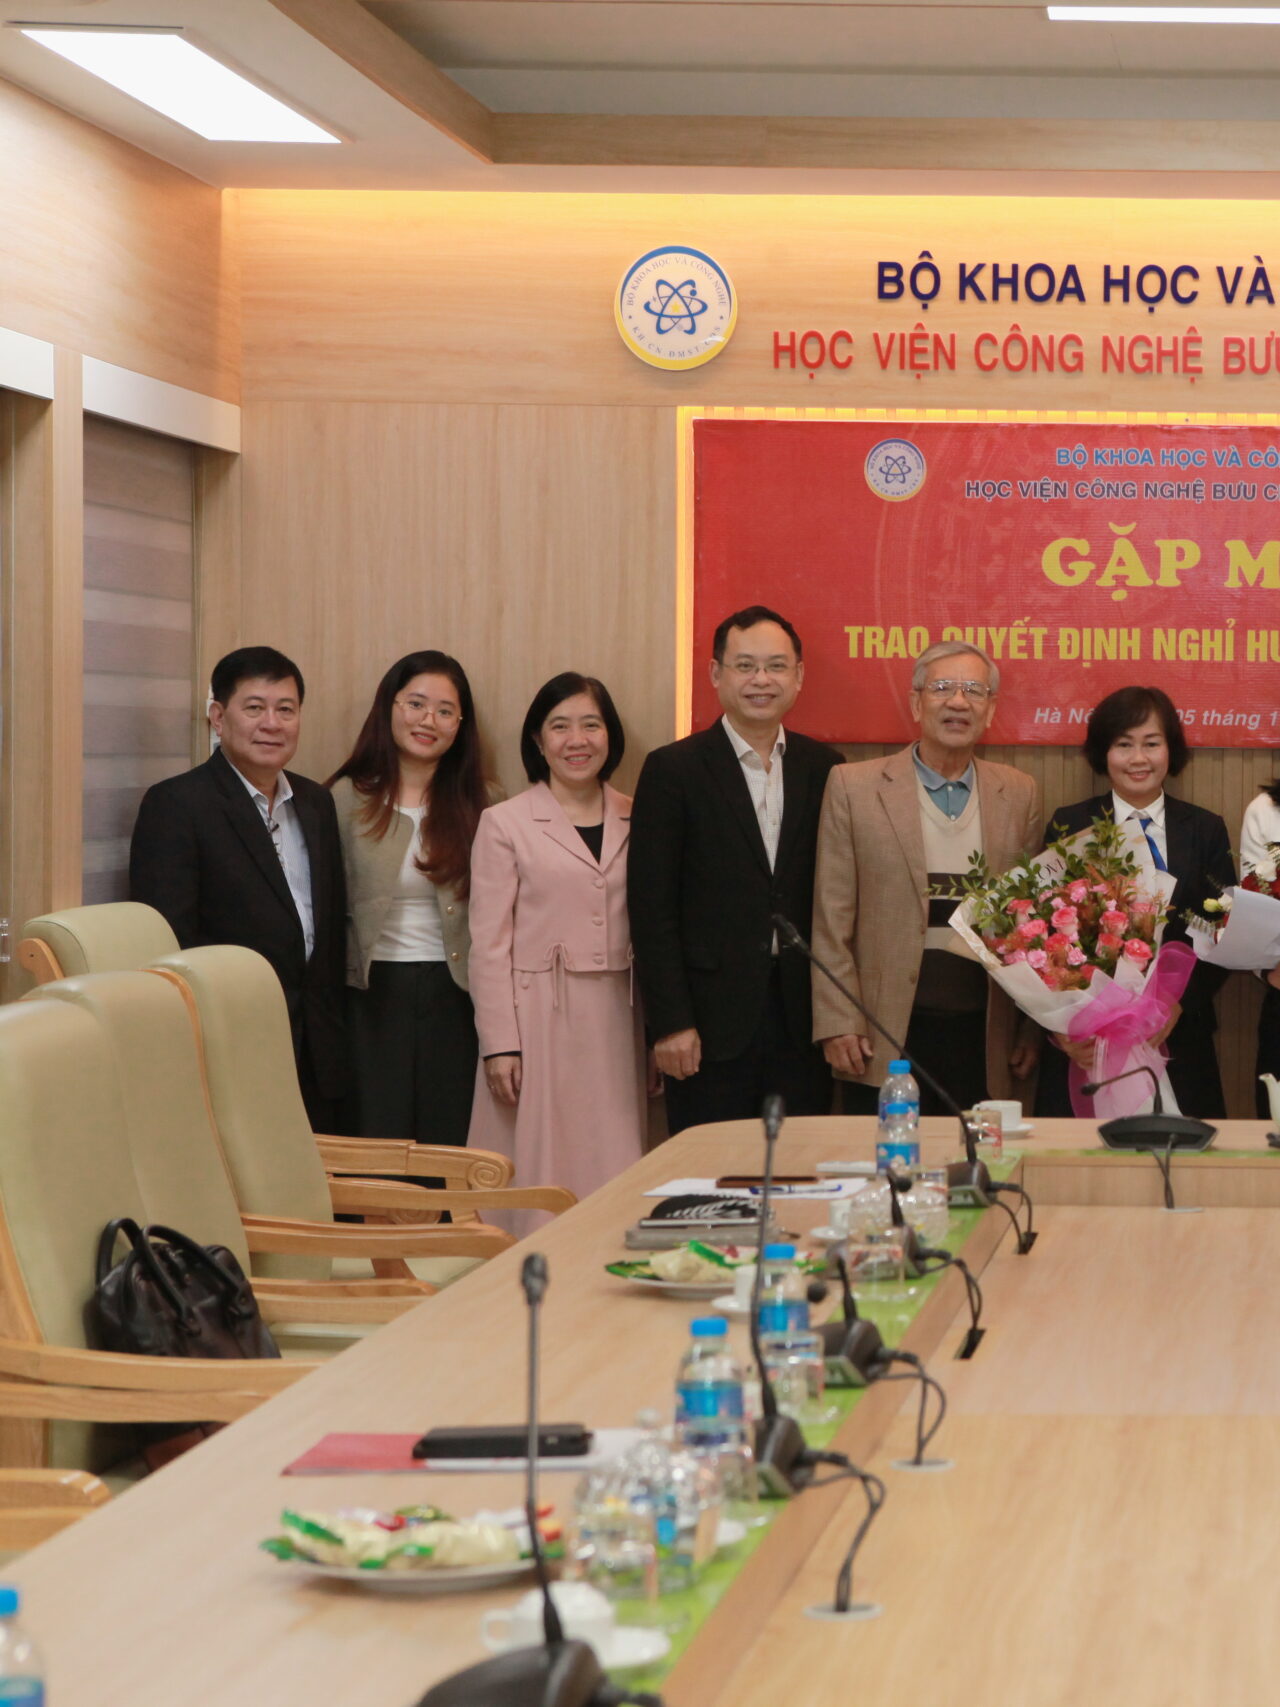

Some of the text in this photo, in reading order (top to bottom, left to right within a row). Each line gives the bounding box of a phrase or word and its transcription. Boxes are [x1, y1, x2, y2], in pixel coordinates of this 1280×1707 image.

[877, 251, 941, 310] BỘ
[959, 263, 1086, 302] KHOA
[1103, 264, 1200, 312] HỌC
[1216, 256, 1275, 304] VÀ
[773, 329, 854, 380] HỌC
[872, 323, 956, 379] VIỆN
[974, 324, 1085, 373] CÔNG
[1101, 326, 1203, 383] NGHỆ
[1056, 443, 1088, 470] BỘ
[1094, 448, 1154, 466] KHOA
[1160, 449, 1207, 470] HỌC
[1213, 445, 1243, 467] VÀ
[965, 479, 1011, 502] HỌC
[1017, 477, 1068, 502] VIỆN
[1074, 477, 1137, 499] CÔNG
[1144, 478, 1206, 504] NGHỆ
[1212, 480, 1256, 500] BƯU
[1042, 522, 1201, 602] GẶP
[844, 626, 930, 659] TRAO
[1057, 627, 1140, 668] ĐỊNH
[1153, 618, 1235, 661] NGHỈ
[1034, 707, 1061, 724] Hà
[1202, 709, 1261, 730] tháng
